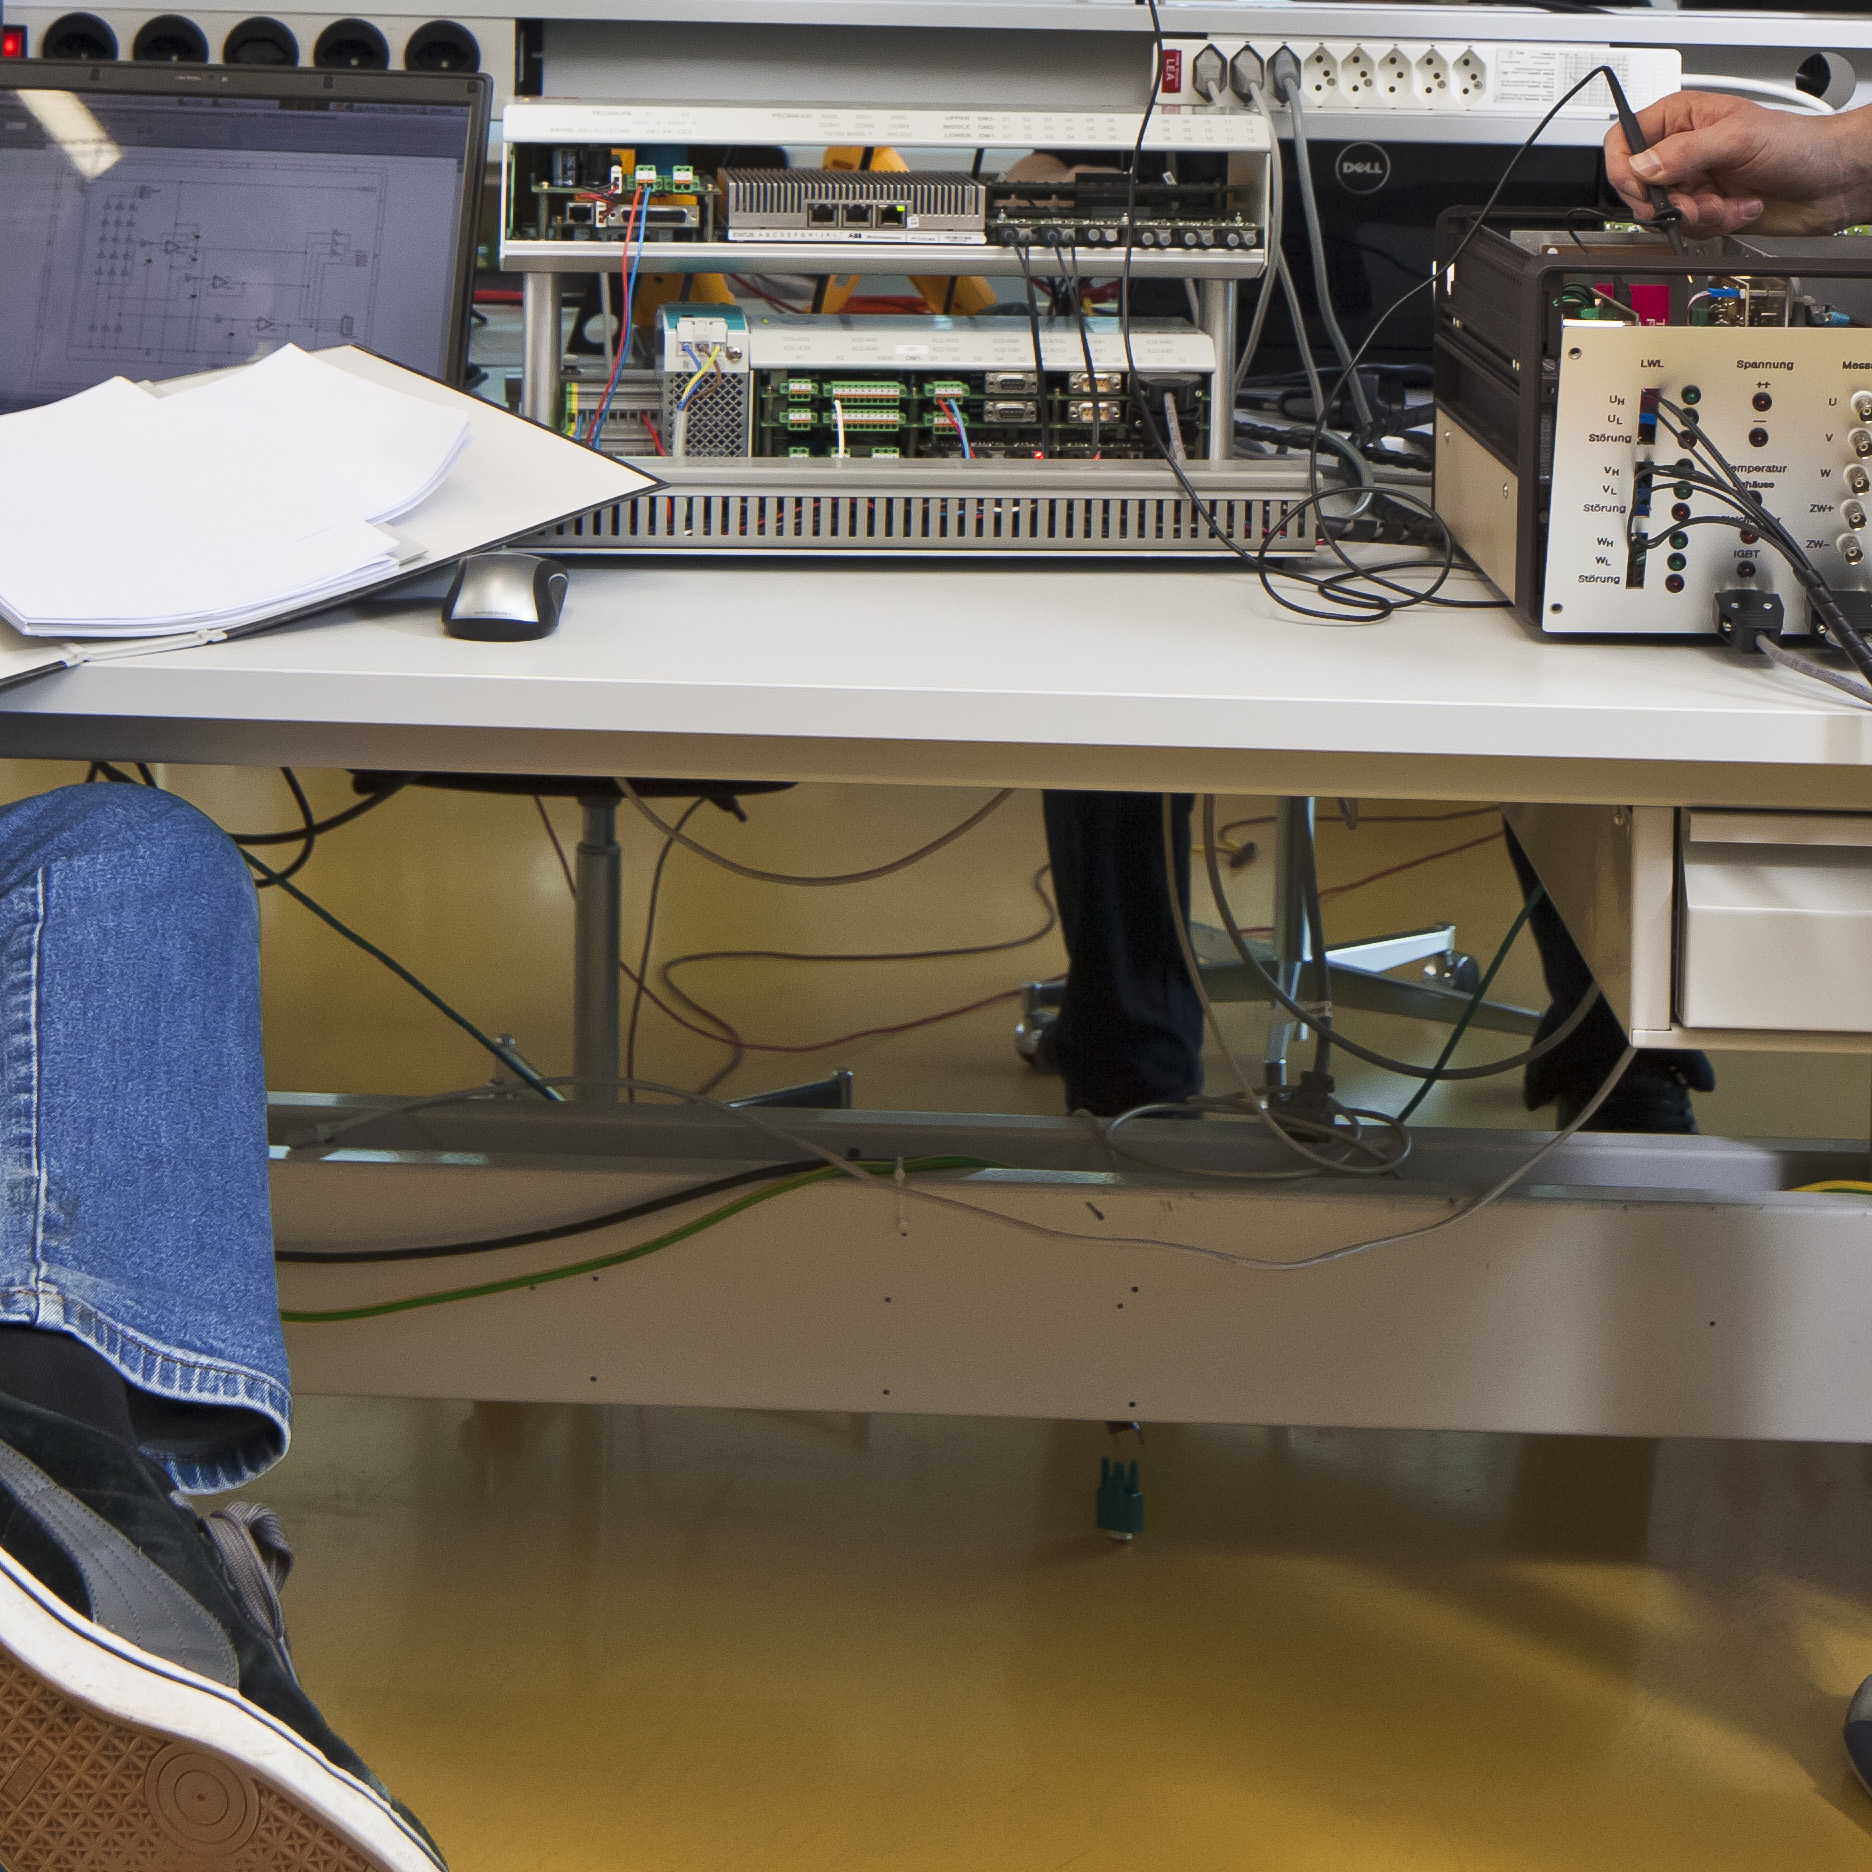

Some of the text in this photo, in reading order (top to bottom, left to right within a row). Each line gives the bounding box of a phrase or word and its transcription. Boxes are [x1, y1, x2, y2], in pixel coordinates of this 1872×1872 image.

[1166, 58, 1175, 82] LEA
[1342, 161, 1384, 174] DELL
[1640, 359, 1664, 368] LWL
[1736, 359, 1795, 370] Spannung
[1828, 397, 1837, 407] U
[1588, 433, 1632, 443] Störung
[1820, 468, 1832, 478] W
[1583, 503, 1626, 514] Störung
[1809, 504, 1834, 513] ZW+
[1733, 549, 1761, 559] IGBT
[1578, 574, 1620, 584] Störung
